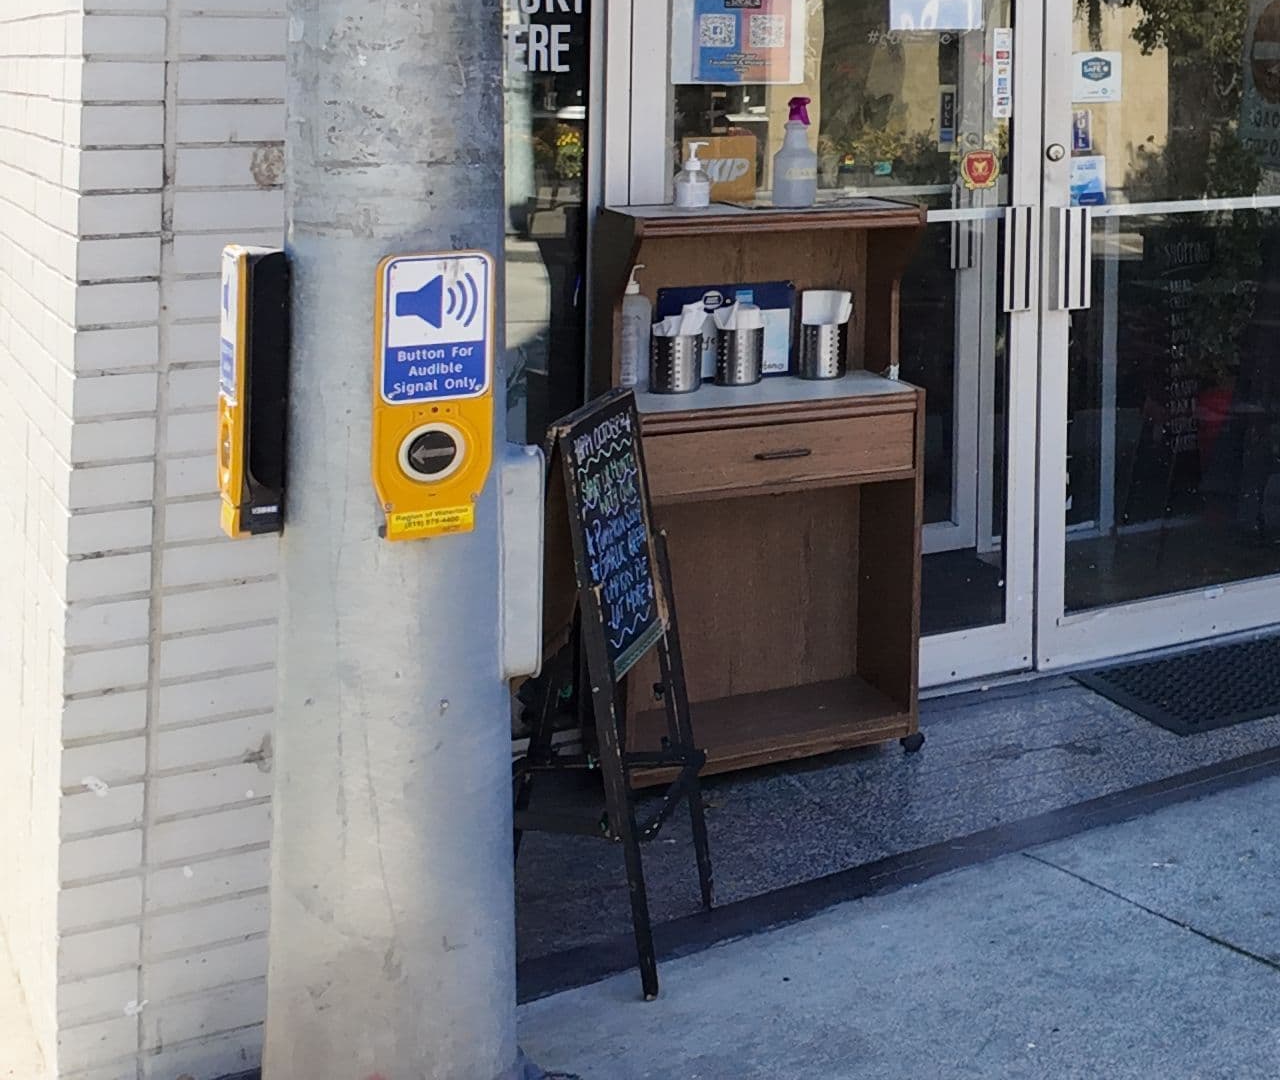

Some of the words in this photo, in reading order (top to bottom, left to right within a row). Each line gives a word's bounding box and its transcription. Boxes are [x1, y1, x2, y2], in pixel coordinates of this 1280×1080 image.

[507, 23, 571, 73] ERE
[1075, 110, 1089, 148] PULL
[397, 347, 445, 362] Button
[451, 346, 474, 358] For
[408, 362, 463, 377] Audible
[393, 379, 438, 397] Signal
[444, 376, 477, 391] Only
